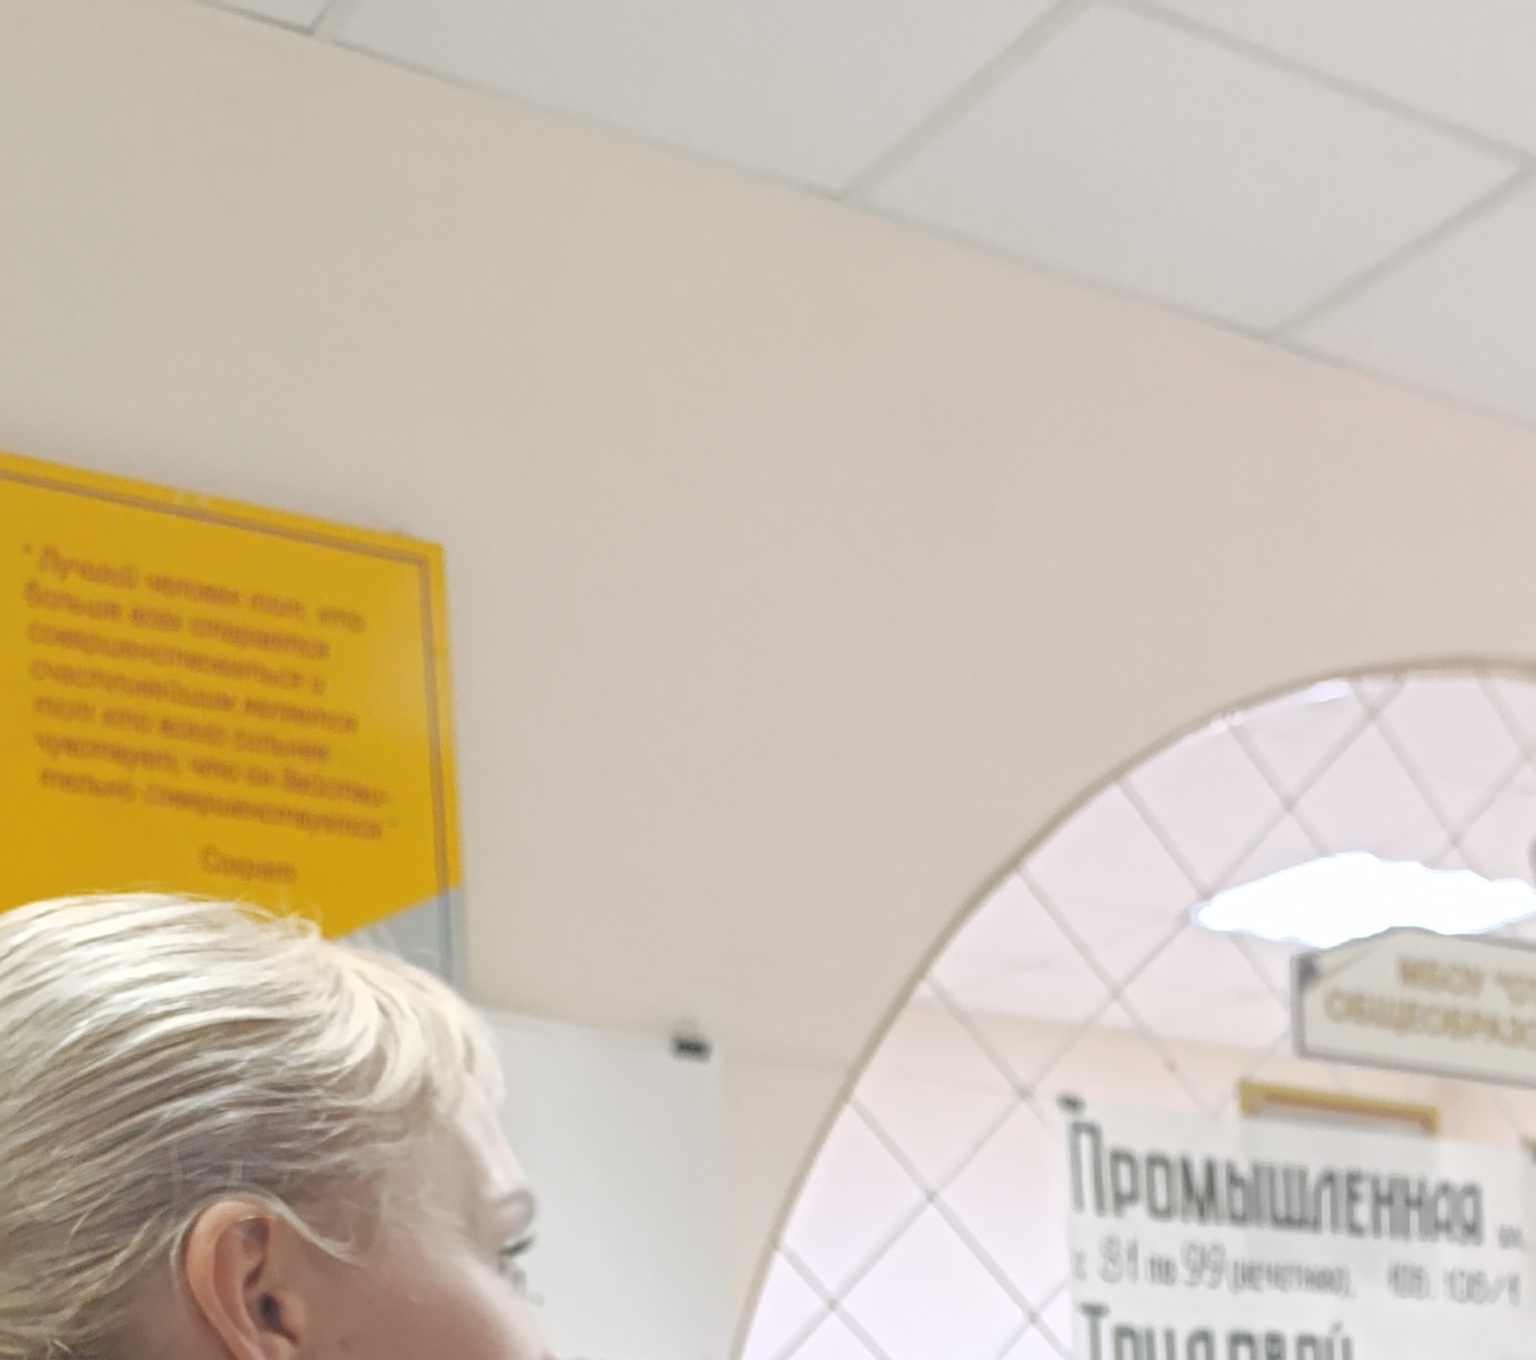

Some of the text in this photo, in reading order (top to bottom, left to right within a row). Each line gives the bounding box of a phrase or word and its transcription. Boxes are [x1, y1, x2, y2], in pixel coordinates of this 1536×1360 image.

[147, 574, 240, 608] человек
[200, 843, 297, 884] Сократ
[1181, 1239, 1227, 1290] 99
